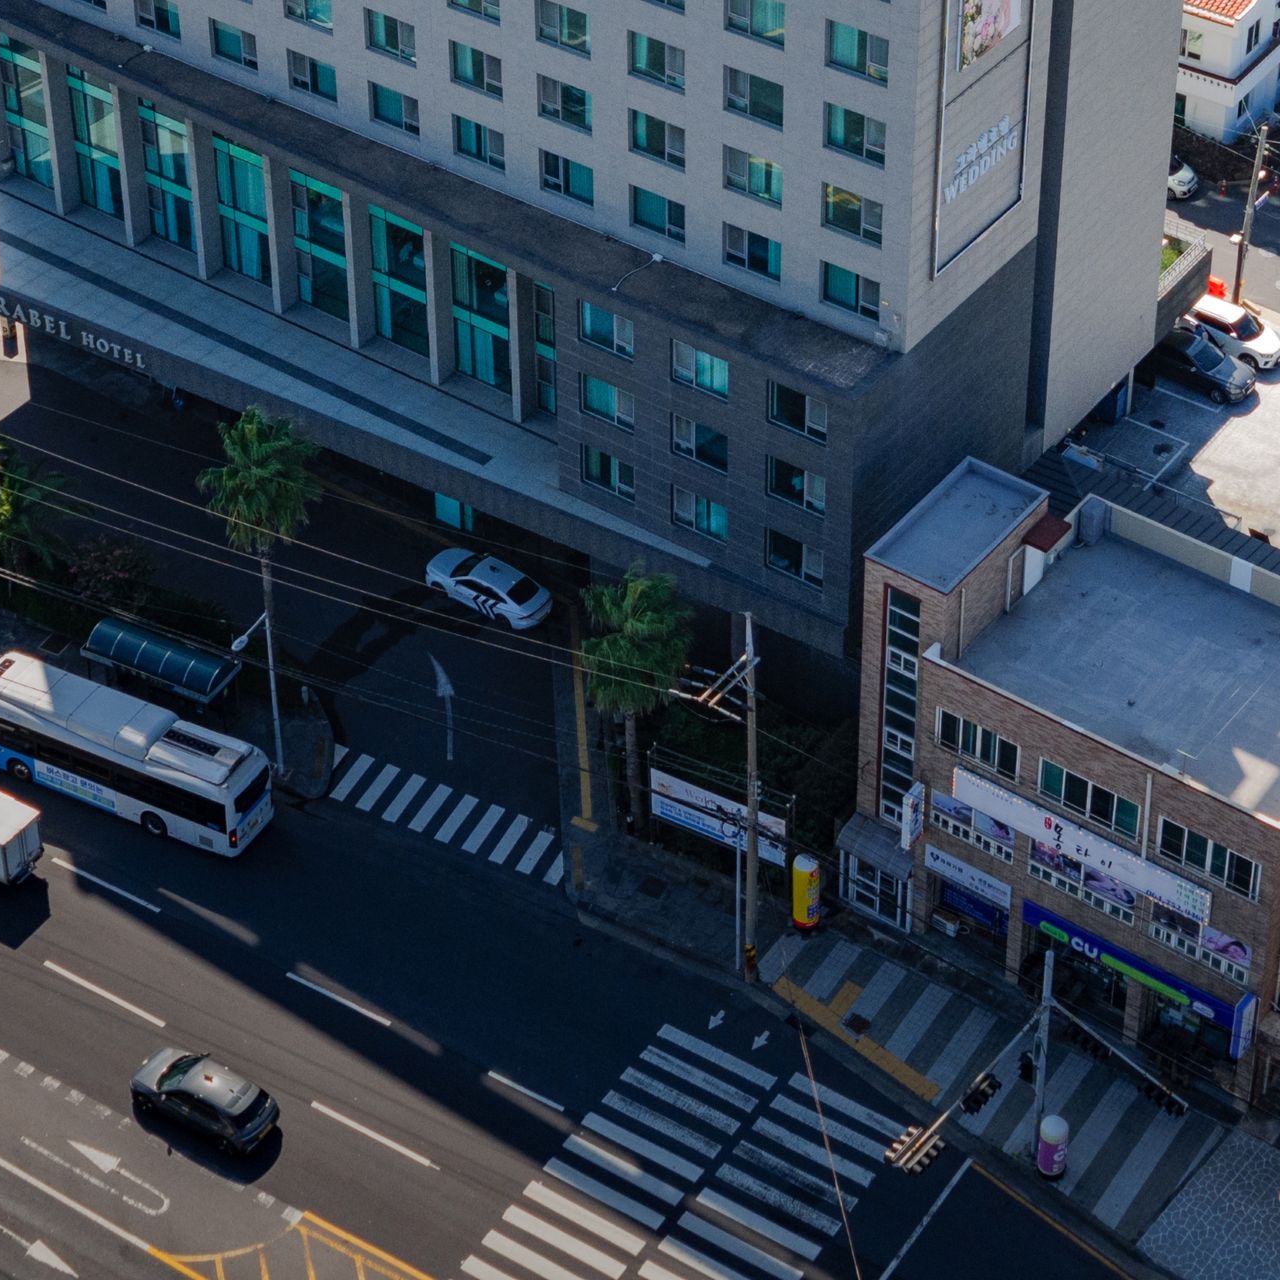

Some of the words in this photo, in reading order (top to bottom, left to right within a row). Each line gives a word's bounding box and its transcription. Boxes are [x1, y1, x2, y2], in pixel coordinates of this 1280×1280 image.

[942, 131, 1018, 205] WEDDING
[80, 330, 146, 369] HOTEL
[1069, 935, 1099, 960] CU
